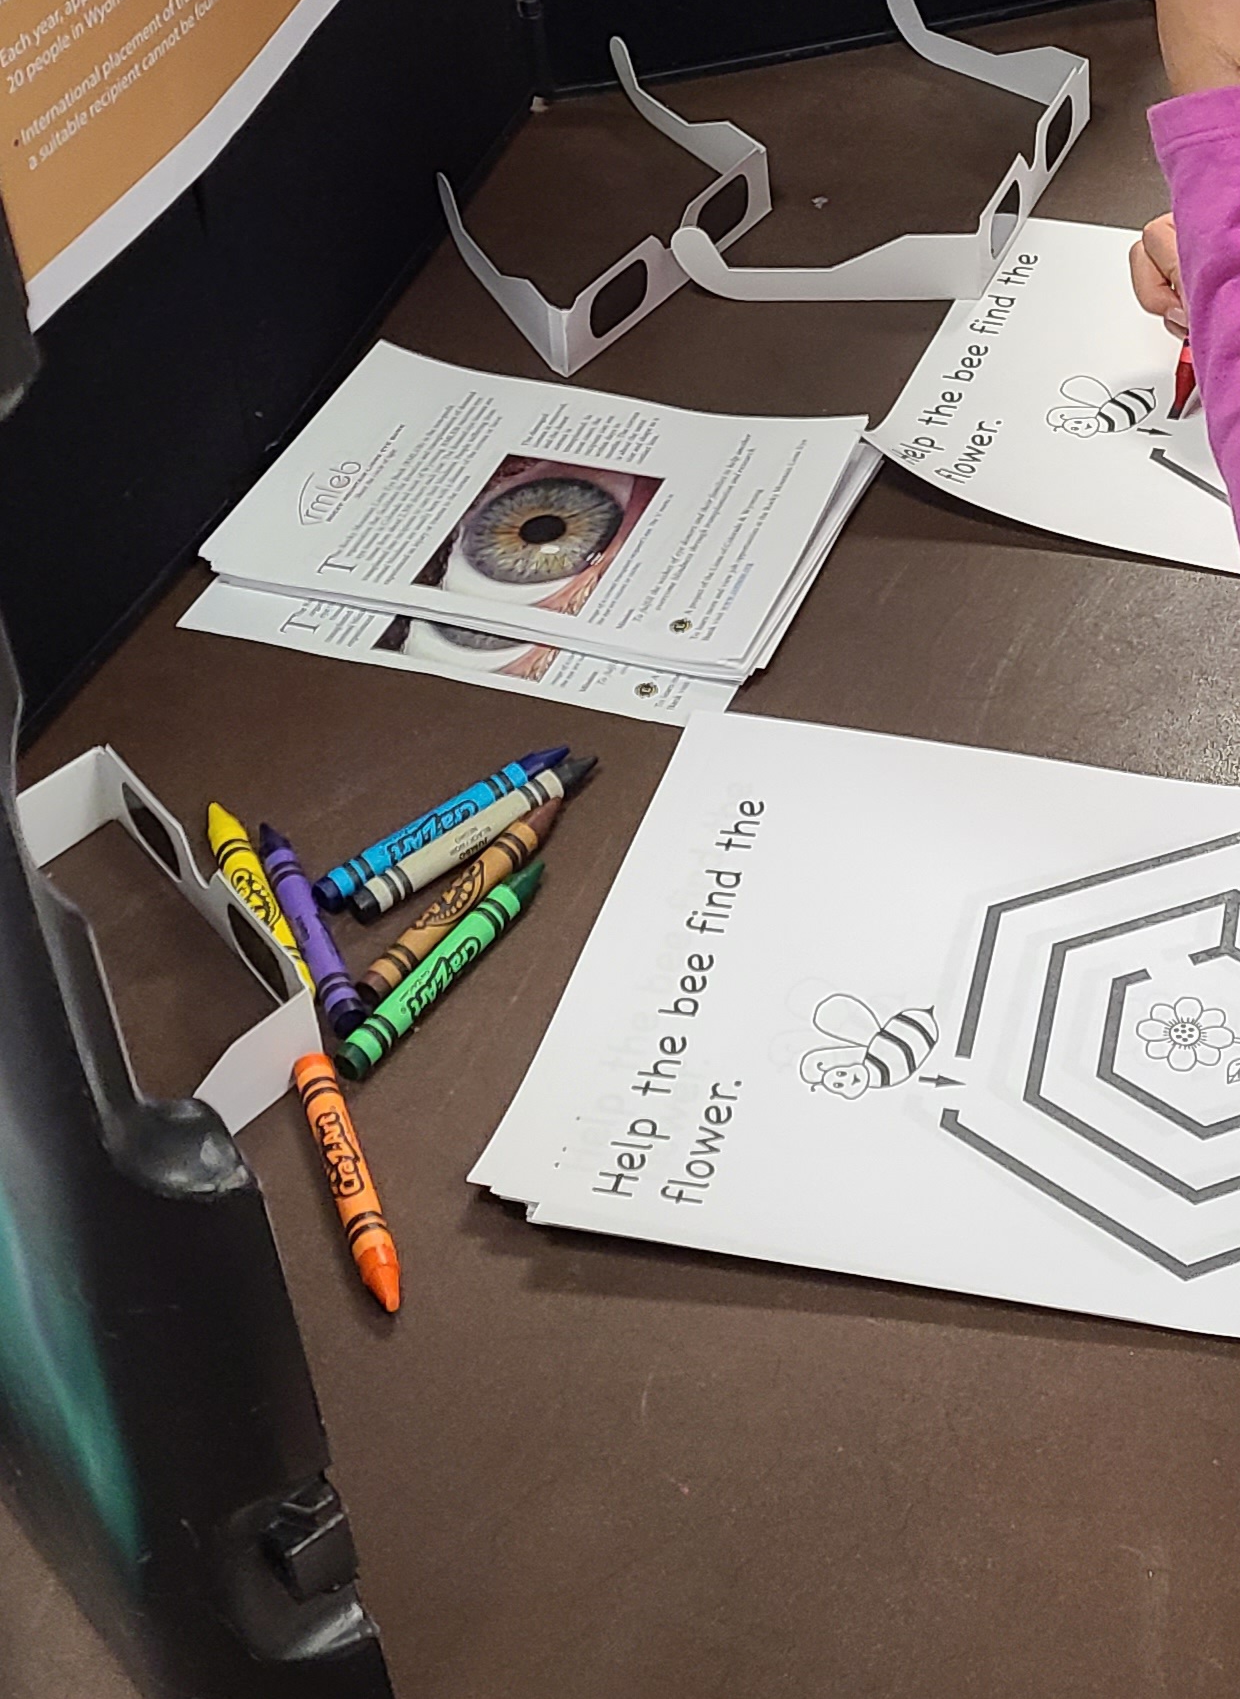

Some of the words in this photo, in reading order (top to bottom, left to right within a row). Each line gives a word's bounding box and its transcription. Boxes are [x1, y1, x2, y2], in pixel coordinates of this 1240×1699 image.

[0, 33, 31, 67] Each
[33, 9, 63, 46] year,
[6, 69, 24, 94] 20
[26, 33, 71, 83] people
[71, 21, 84, 40] in
[20, 65, 100, 145] International
[101, 13, 162, 80] placement
[28, 155, 38, 171] a
[38, 111, 88, 162] suitable
[89, 63, 142, 119] recipient
[142, 27, 181, 71] cannot
[179, 14, 195, 35] be
[918, 392, 962, 425] the
[943, 345, 988, 381] bee
[970, 294, 1016, 334] find
[996, 253, 1039, 285] the
[935, 419, 1003, 484] flower.
[715, 800, 765, 852] the
[686, 870, 742, 933] find
[658, 954, 714, 1016] bee
[631, 1035, 688, 1096] the
[592, 1118, 671, 1197] Help
[661, 1079, 743, 1204] flower.
